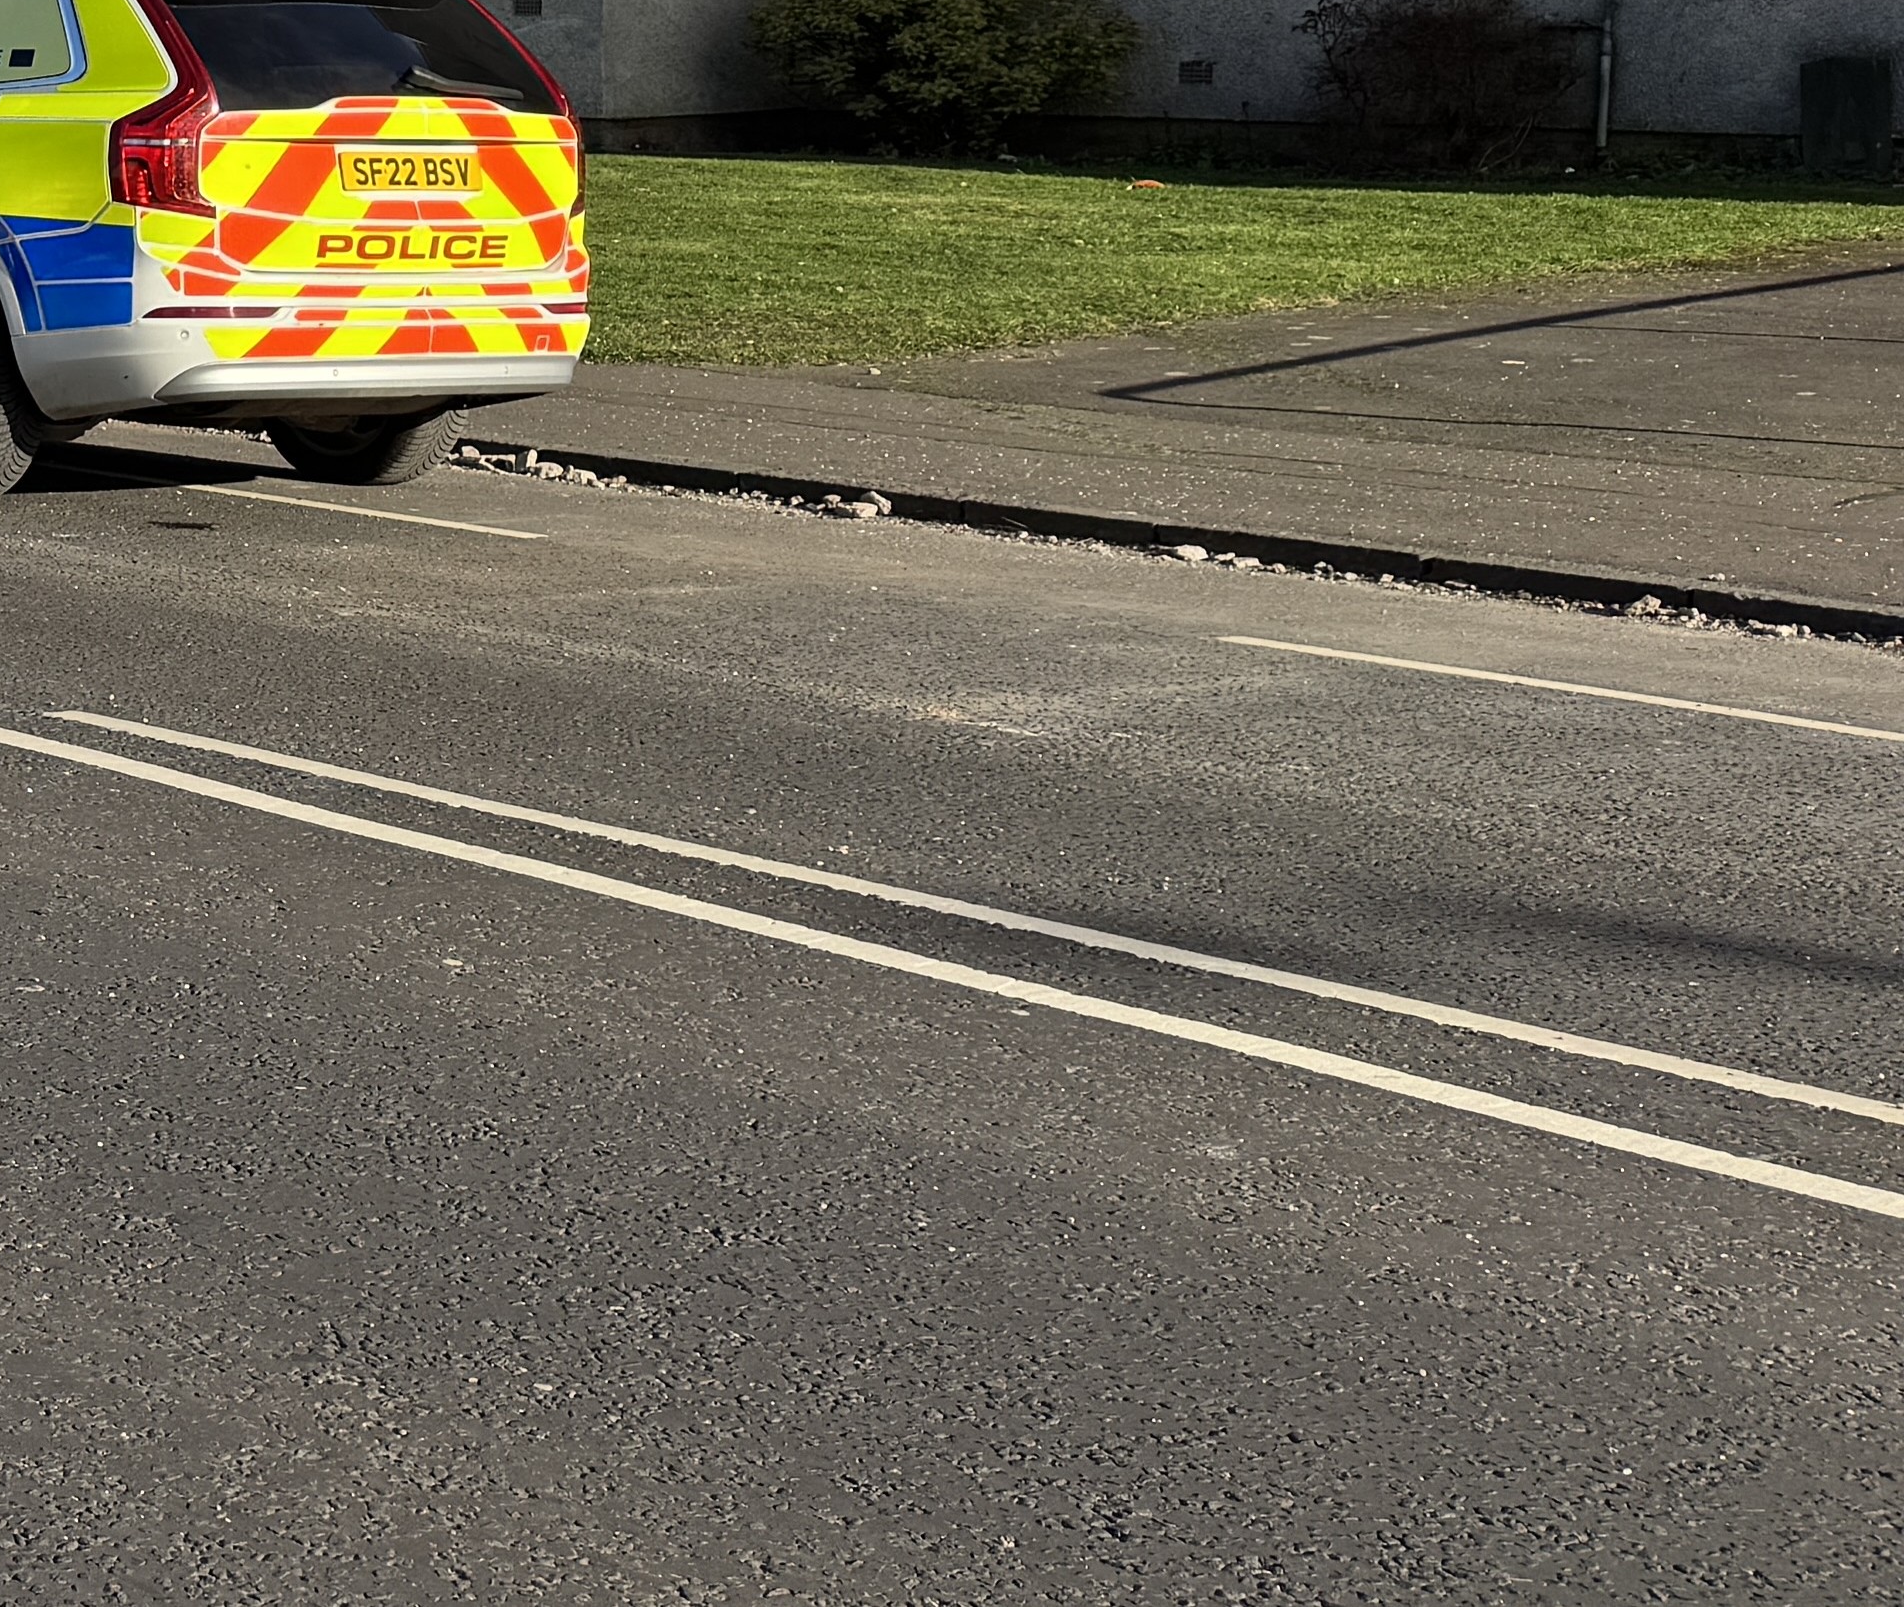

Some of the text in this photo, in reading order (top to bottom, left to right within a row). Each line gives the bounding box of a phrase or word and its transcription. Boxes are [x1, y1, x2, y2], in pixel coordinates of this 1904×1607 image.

[353, 157, 469, 186] SF22 BSV
[316, 234, 509, 260] POLICE
